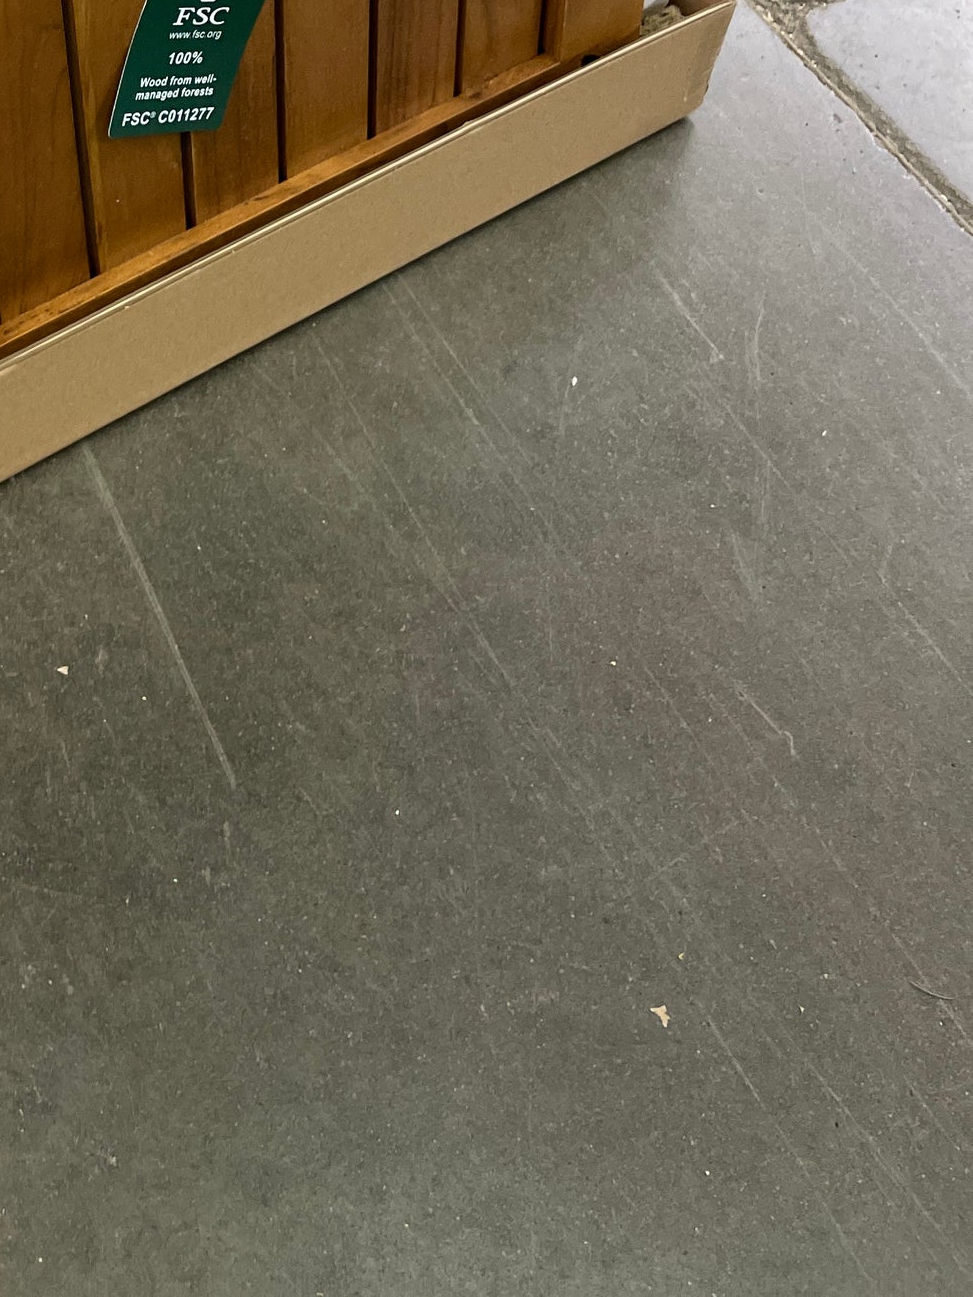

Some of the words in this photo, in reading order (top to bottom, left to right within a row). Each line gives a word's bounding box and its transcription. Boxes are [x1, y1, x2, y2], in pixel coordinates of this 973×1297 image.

[173, 7, 230, 26] FSC
[169, 29, 222, 40] www.fsc.org
[168, 51, 203, 65] 100%
[140, 76, 168, 88] Wood
[169, 75, 192, 86] from
[194, 73, 217, 84] well-
[135, 88, 179, 101] managed
[181, 86, 214, 97] forests
[158, 106, 215, 124] C011277
